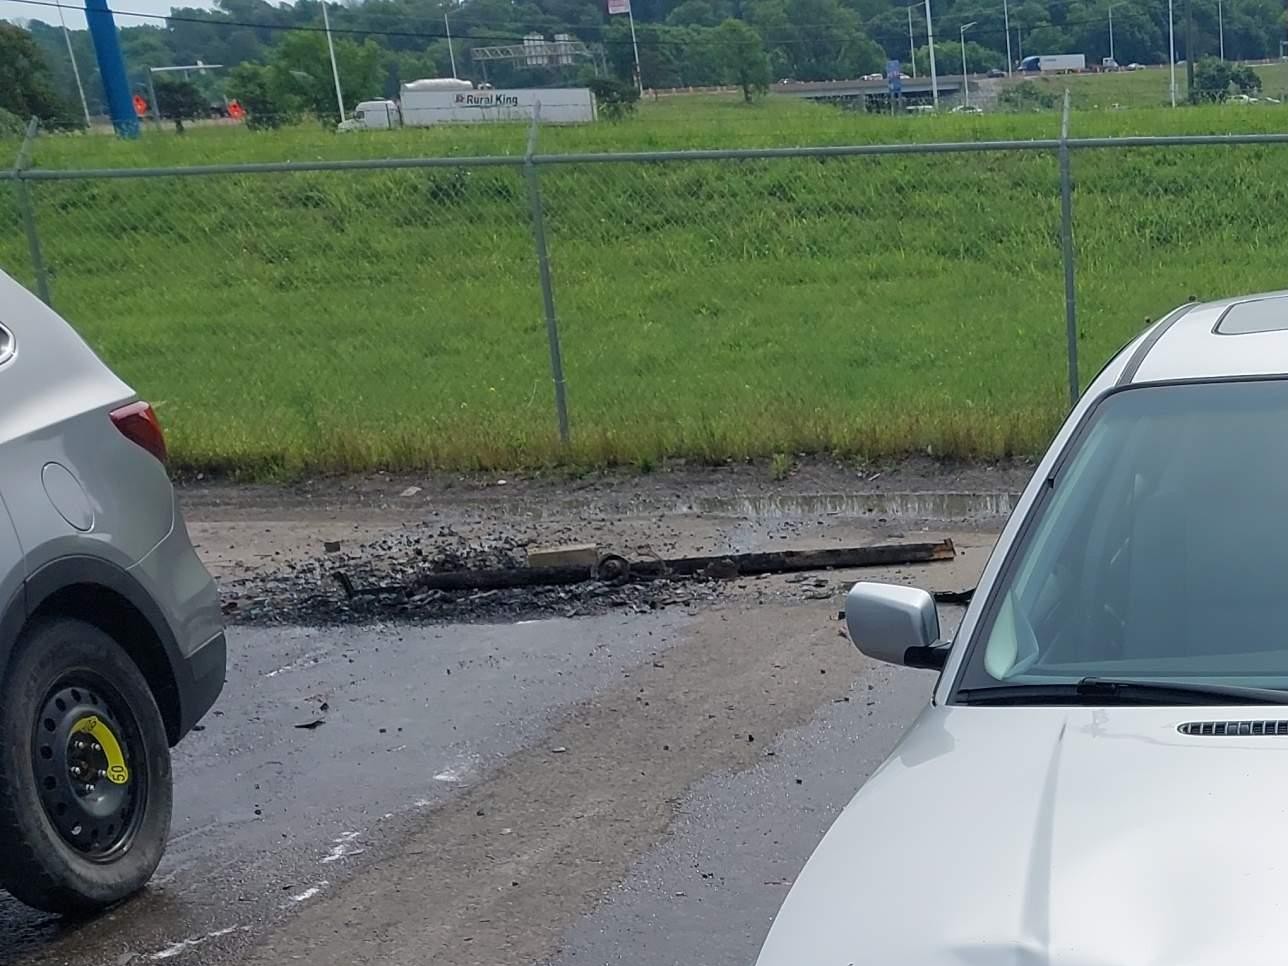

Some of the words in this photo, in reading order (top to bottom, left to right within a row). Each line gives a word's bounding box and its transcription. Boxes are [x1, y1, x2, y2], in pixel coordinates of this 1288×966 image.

[466, 94, 493, 105] Rural
[495, 94, 518, 106] King
[111, 765, 125, 781] 50
